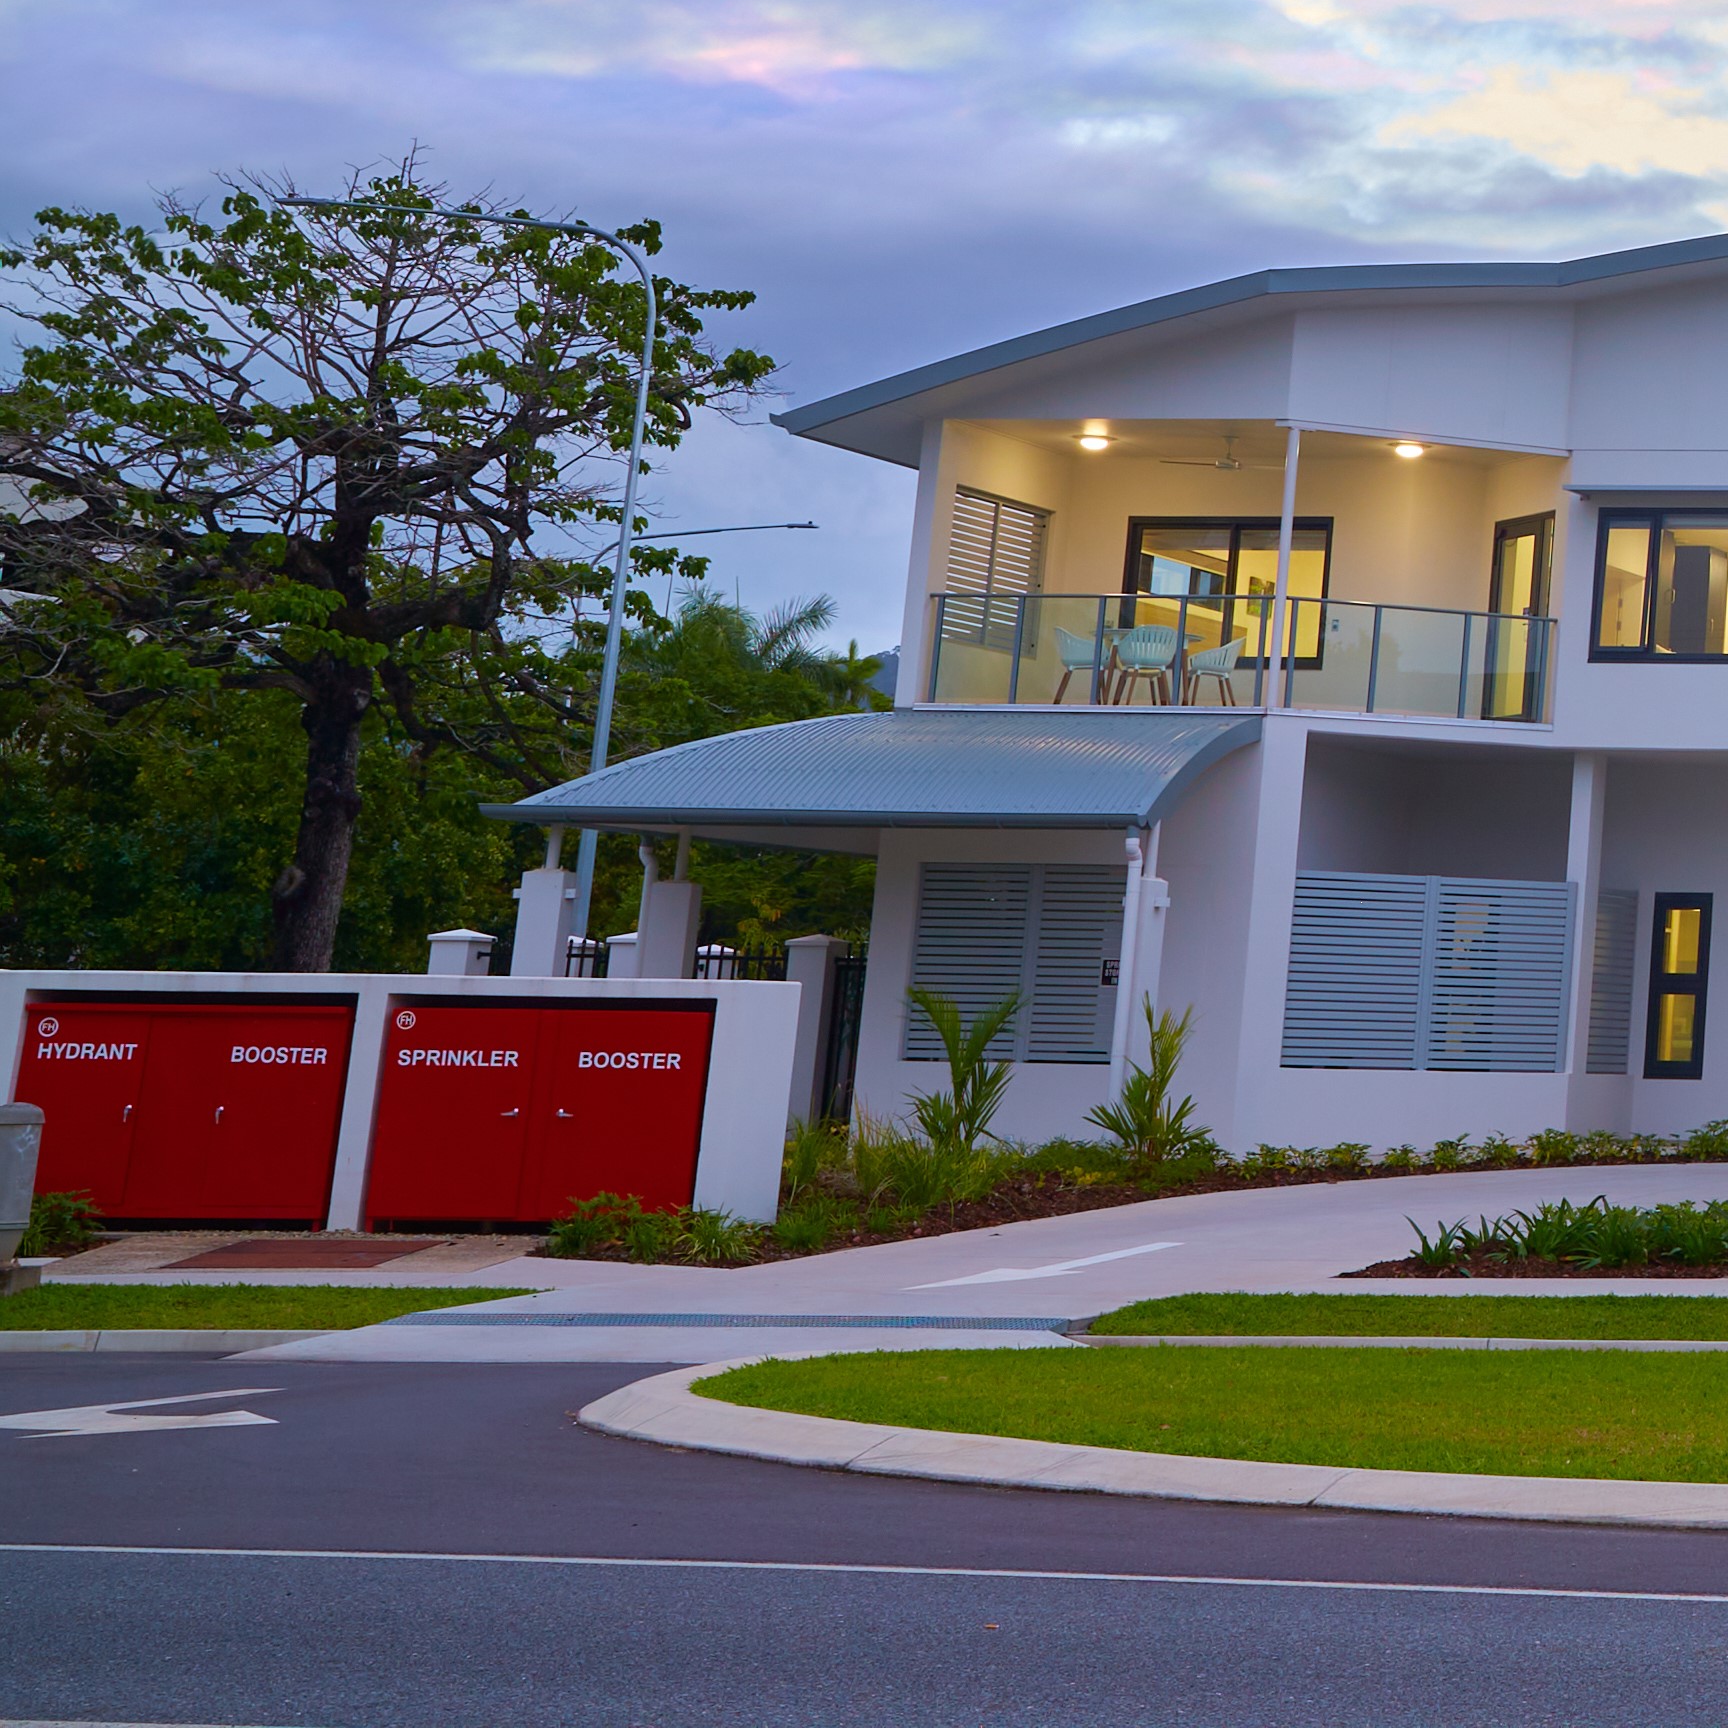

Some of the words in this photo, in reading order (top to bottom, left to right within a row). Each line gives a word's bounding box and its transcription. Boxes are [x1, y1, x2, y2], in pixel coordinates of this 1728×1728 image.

[41, 1022, 56, 1032] FH
[399, 1014, 413, 1026] FH
[37, 1042, 139, 1061] HYDRANT
[230, 1045, 328, 1065] BOOSTER
[397, 1049, 519, 1067] SPRINKLER
[578, 1051, 681, 1070] BOOSTER
